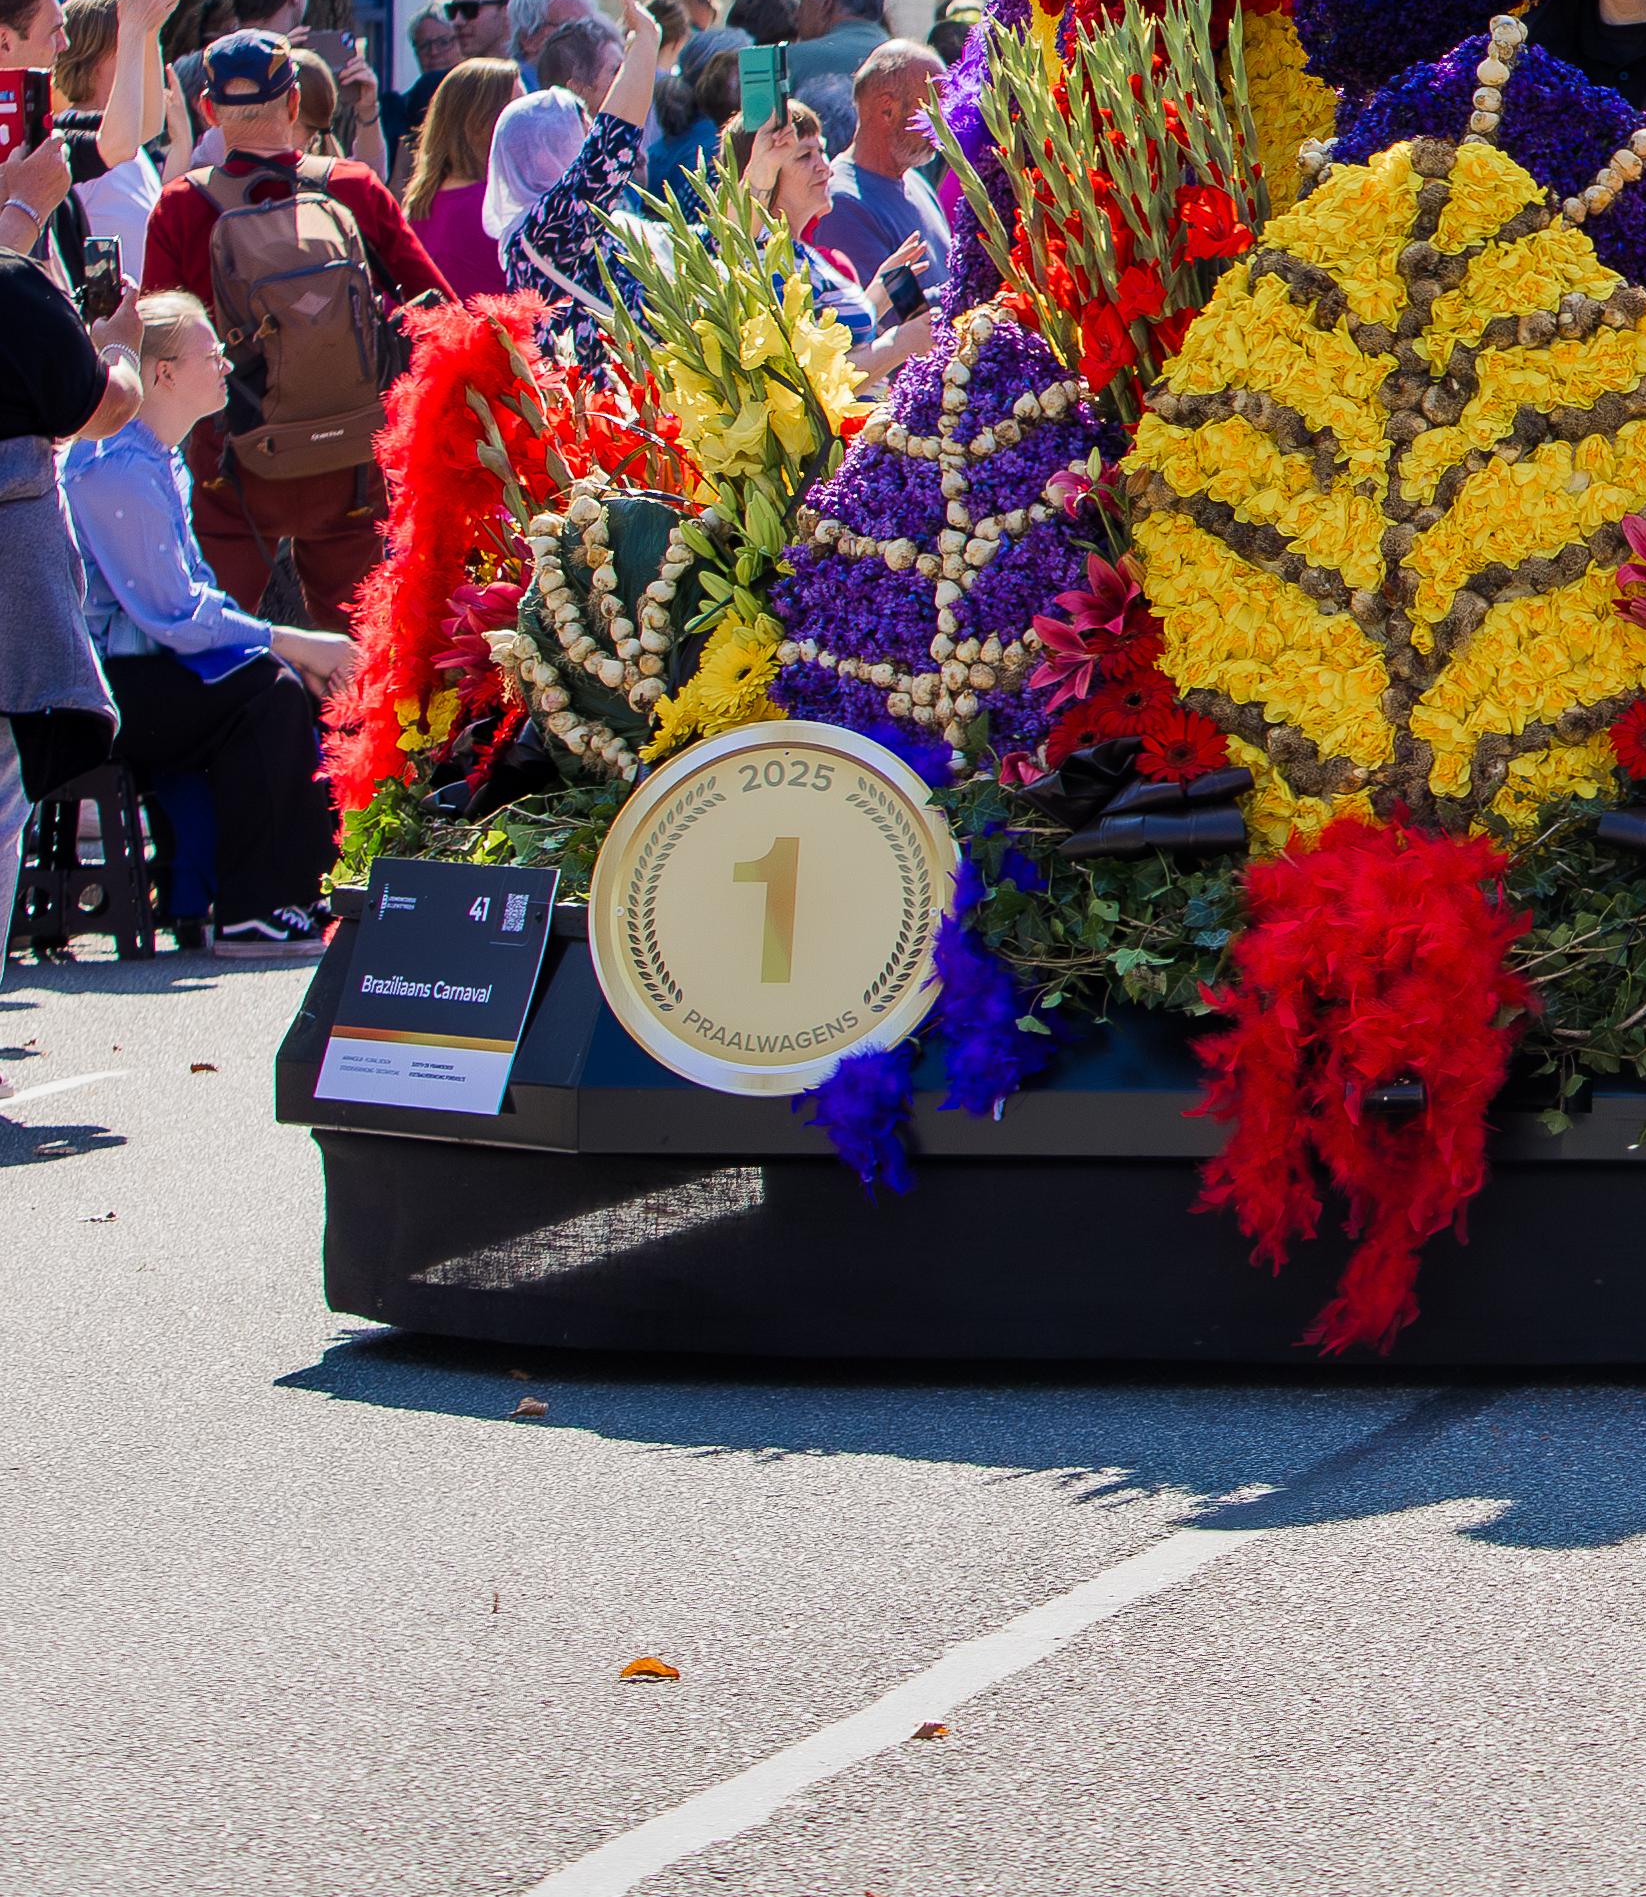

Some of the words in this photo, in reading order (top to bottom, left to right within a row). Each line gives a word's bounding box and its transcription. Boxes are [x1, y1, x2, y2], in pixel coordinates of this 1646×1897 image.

[737, 759, 836, 794] 2025
[468, 896, 491, 922] 41
[732, 836, 801, 984] 1
[361, 975, 432, 998] Braziliaans
[433, 981, 493, 1004] Carnaval
[681, 1008, 859, 1053] PRAALWAGENS
